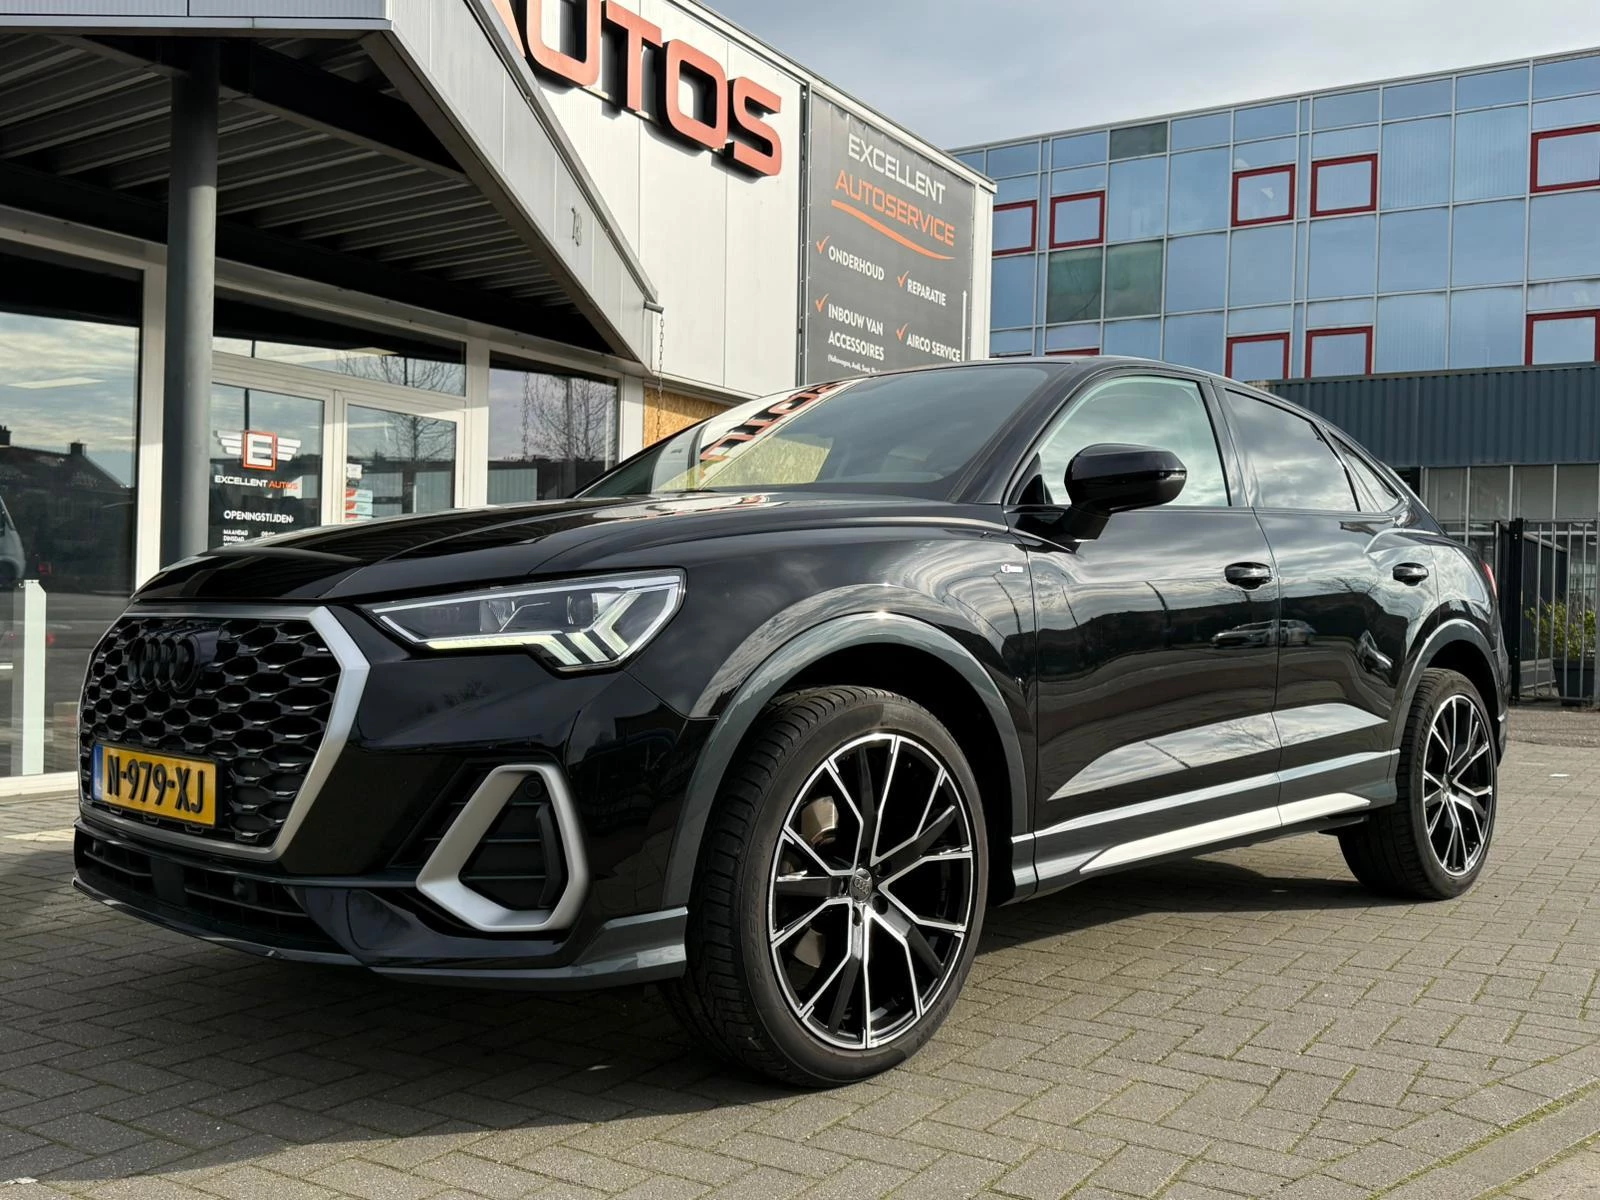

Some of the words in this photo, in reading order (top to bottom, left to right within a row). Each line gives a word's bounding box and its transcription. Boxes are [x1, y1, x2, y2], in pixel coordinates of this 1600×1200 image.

[490, 0, 782, 176] UTOS
[848, 133, 946, 204] EXCELLENT
[835, 170, 955, 246] AUTOSERVICE
[828, 246, 885, 281] ONDERHOUD
[907, 279, 947, 307] REPARATIE
[828, 303, 866, 331] INBOUW
[866, 318, 884, 336] VAN
[828, 330, 885, 361] ACCESSOIRES
[906, 333, 931, 353] AIRCO
[931, 341, 961, 363] SERVICE
[214, 475, 268, 487] EXCELLENT
[268, 480, 298, 490] AUTOS
[107, 754, 205, 814] N-979-XJ
